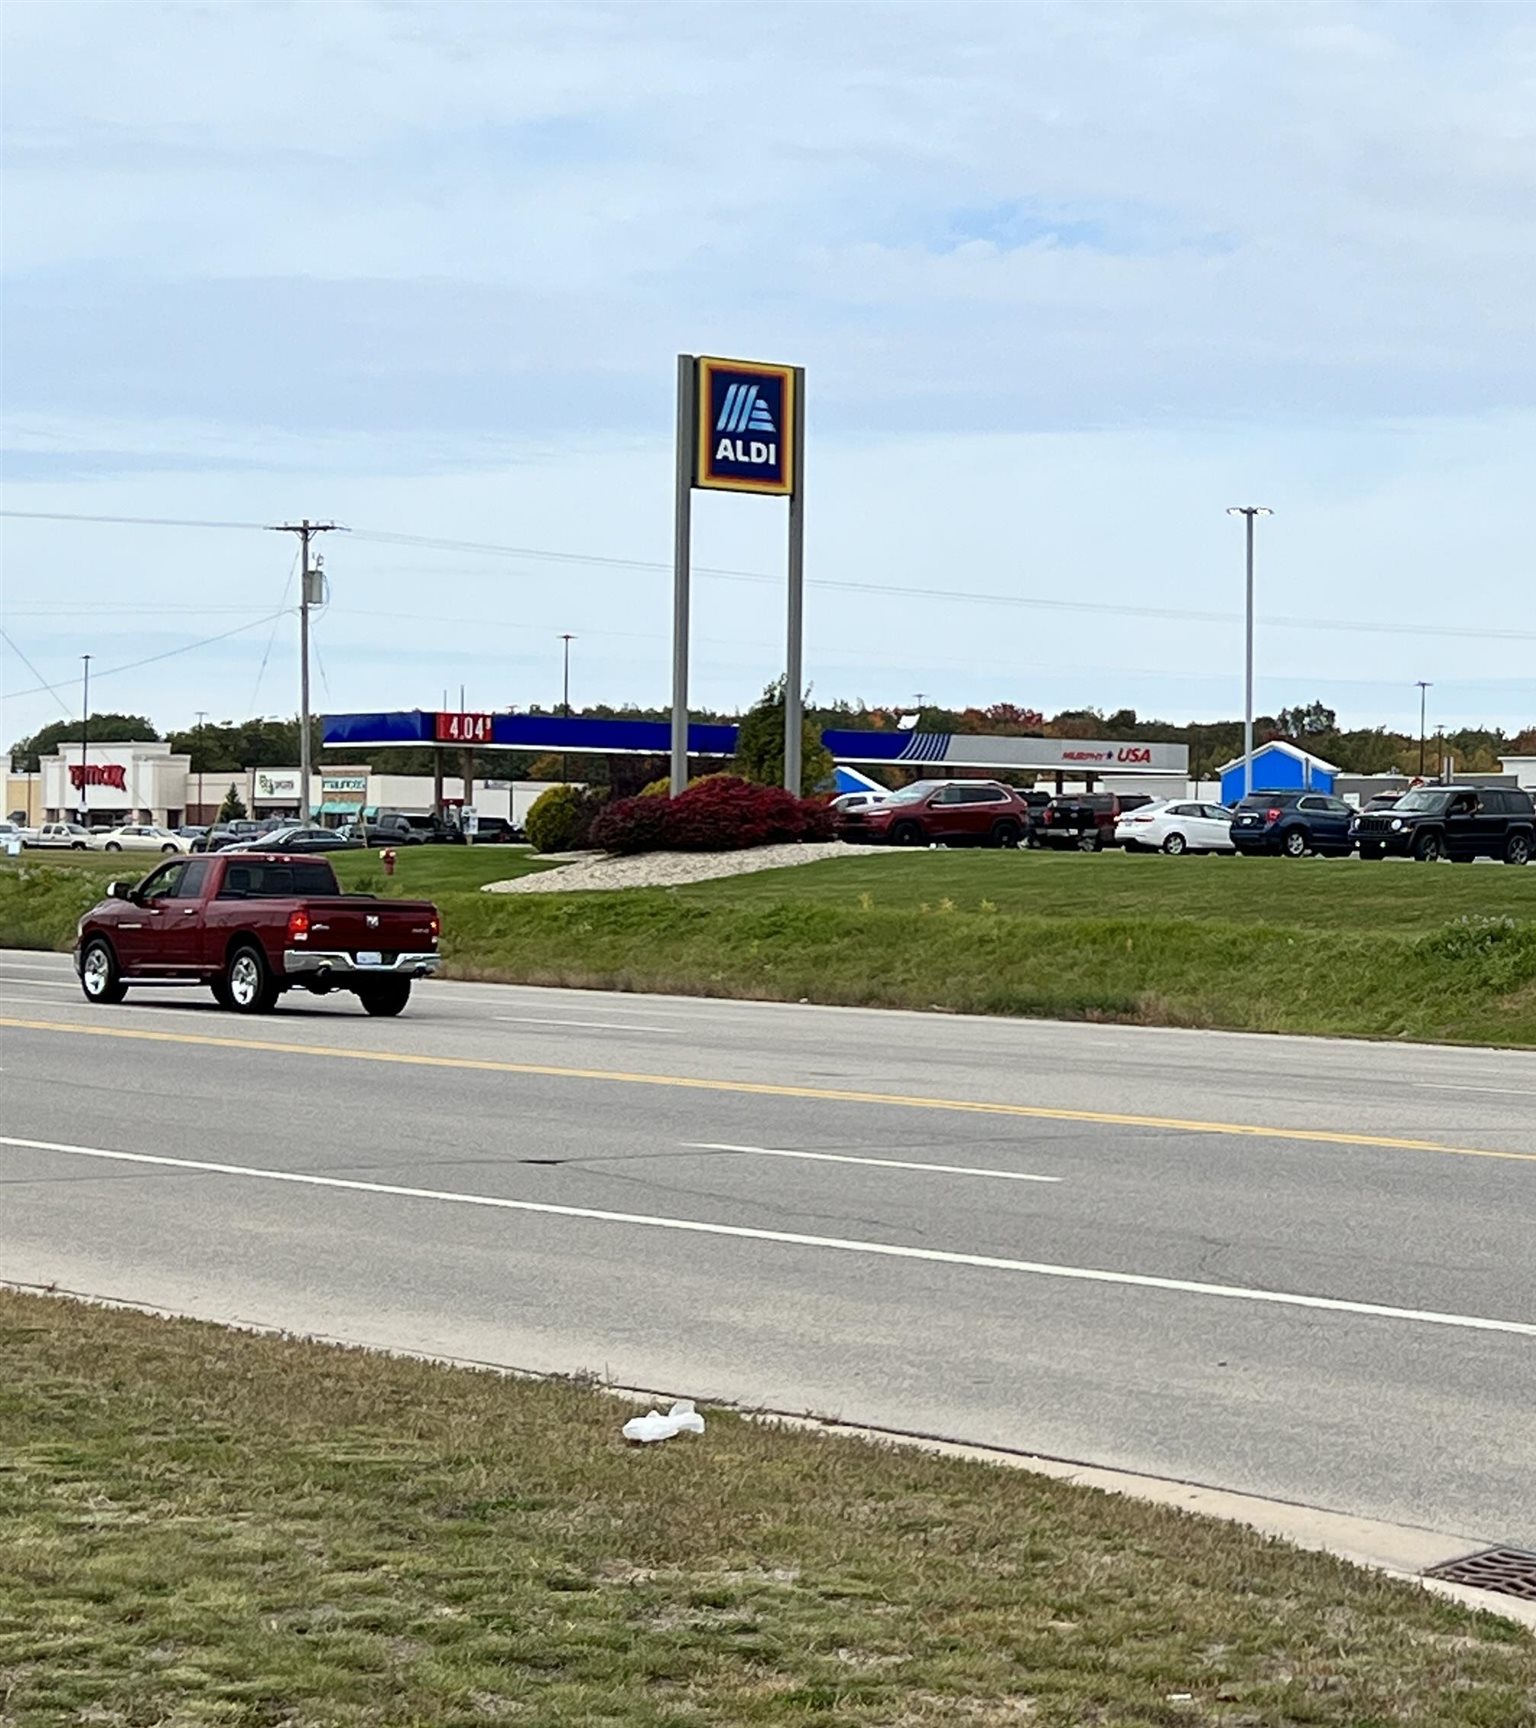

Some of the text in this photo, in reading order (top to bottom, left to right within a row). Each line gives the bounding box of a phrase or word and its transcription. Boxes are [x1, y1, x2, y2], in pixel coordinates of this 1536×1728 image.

[715, 438, 777, 466] ALDI
[449, 716, 484, 740] 4.04
[1062, 747, 1152, 763] MURPHY USA
